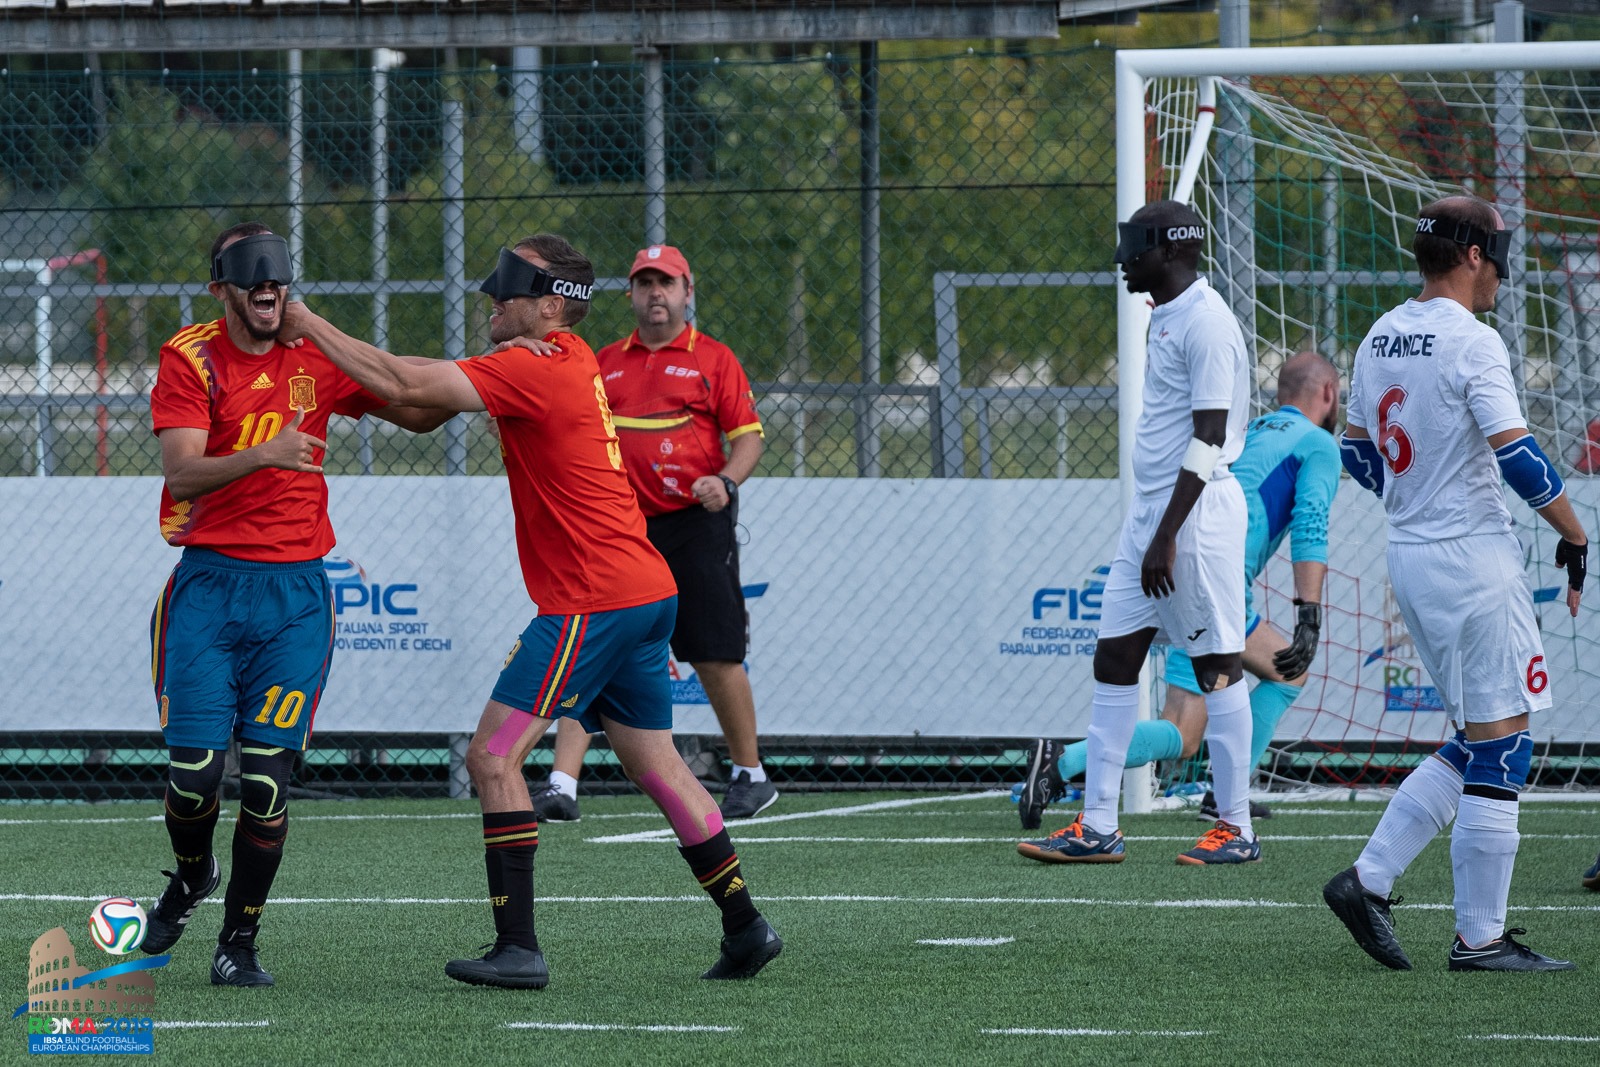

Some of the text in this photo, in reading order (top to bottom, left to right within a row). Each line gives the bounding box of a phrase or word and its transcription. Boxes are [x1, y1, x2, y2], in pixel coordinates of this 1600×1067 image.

[1371, 334, 1436, 358] FRANCE
[664, 365, 700, 378] ESP
[232, 411, 283, 450] 10
[1376, 384, 1415, 478] 6
[335, 584, 418, 615] PIC
[1033, 588, 1104, 620] FIS
[336, 622, 429, 634] TALIANA SPORT
[1022, 627, 1099, 640] FEDERAZION
[335, 638, 452, 650] OVEDENTI E CIECHI
[1000, 642, 1071, 656] PARALIMPICI
[1526, 655, 1548, 695] 6
[254, 685, 306, 729] 10
[490, 895, 509, 906] FEF
